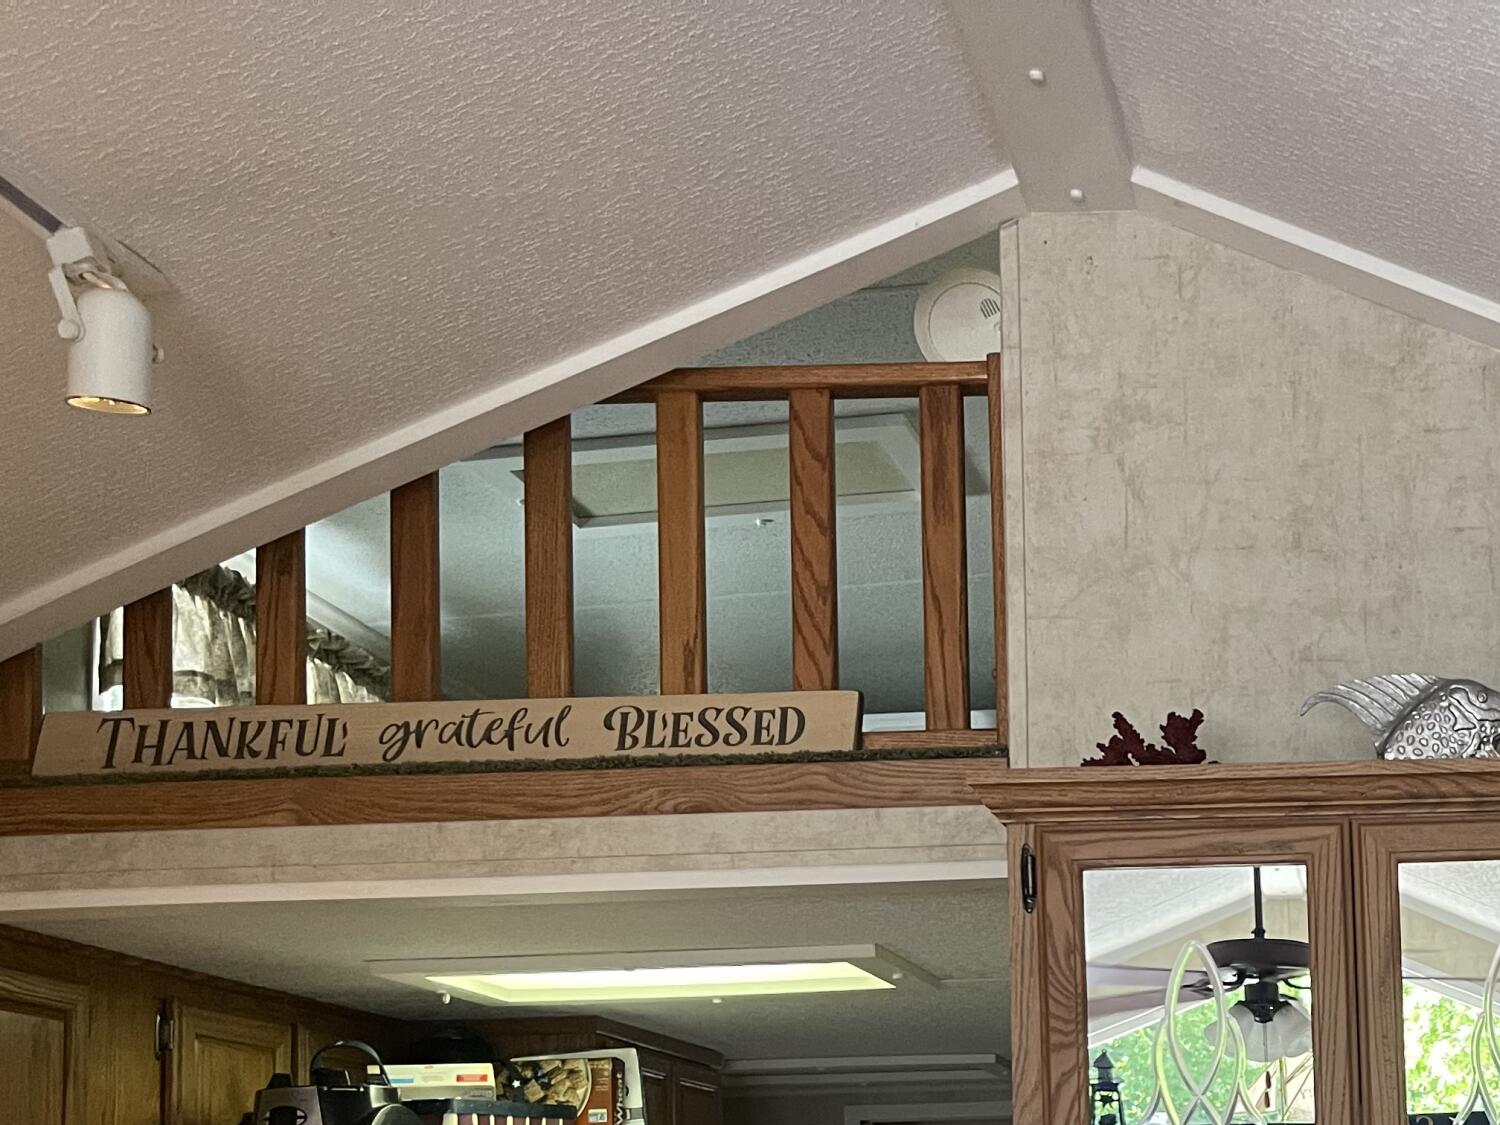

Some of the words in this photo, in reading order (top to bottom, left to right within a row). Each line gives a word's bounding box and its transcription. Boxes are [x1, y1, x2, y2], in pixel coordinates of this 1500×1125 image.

[97, 713, 348, 769] THANKFUL
[378, 704, 572, 762] grateful
[603, 705, 806, 752] BLESSED
